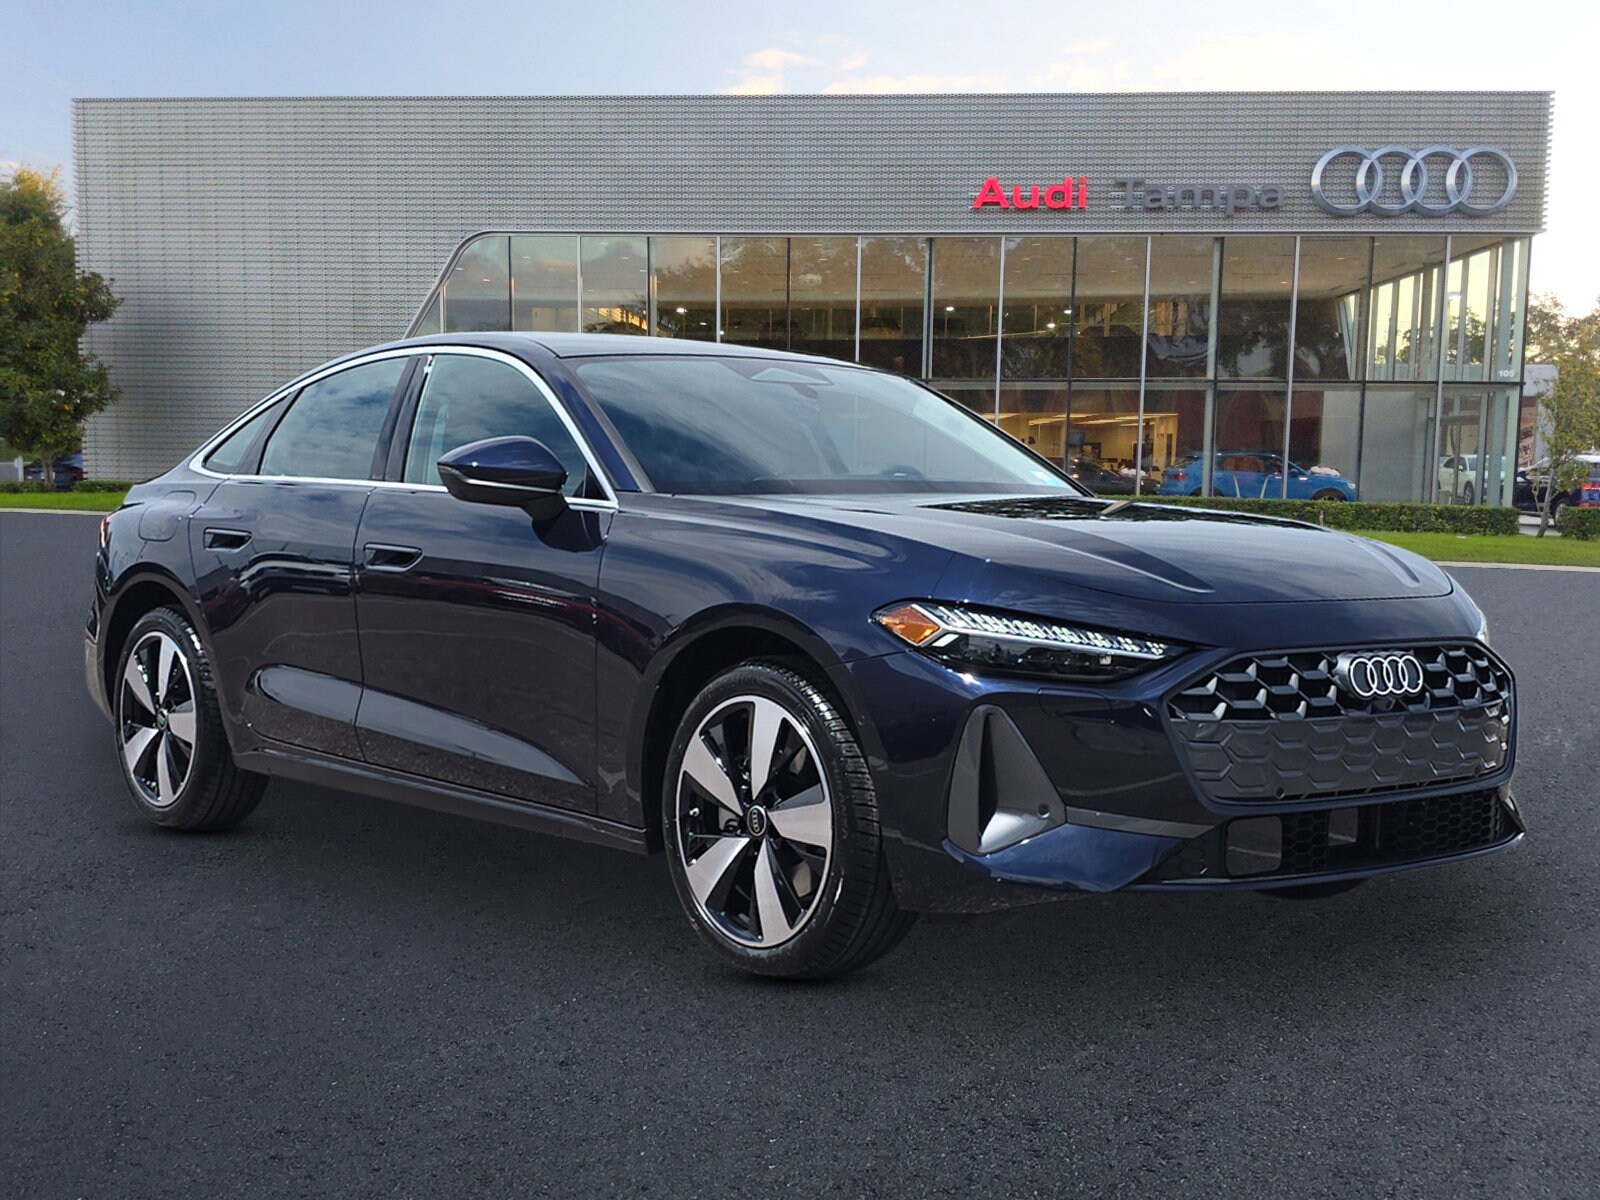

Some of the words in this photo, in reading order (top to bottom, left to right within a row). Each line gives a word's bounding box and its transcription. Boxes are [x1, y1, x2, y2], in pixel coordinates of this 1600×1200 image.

[972, 177, 1088, 210] Audi
[1115, 177, 1285, 218] Tampa
[1499, 370, 1515, 378] 105
